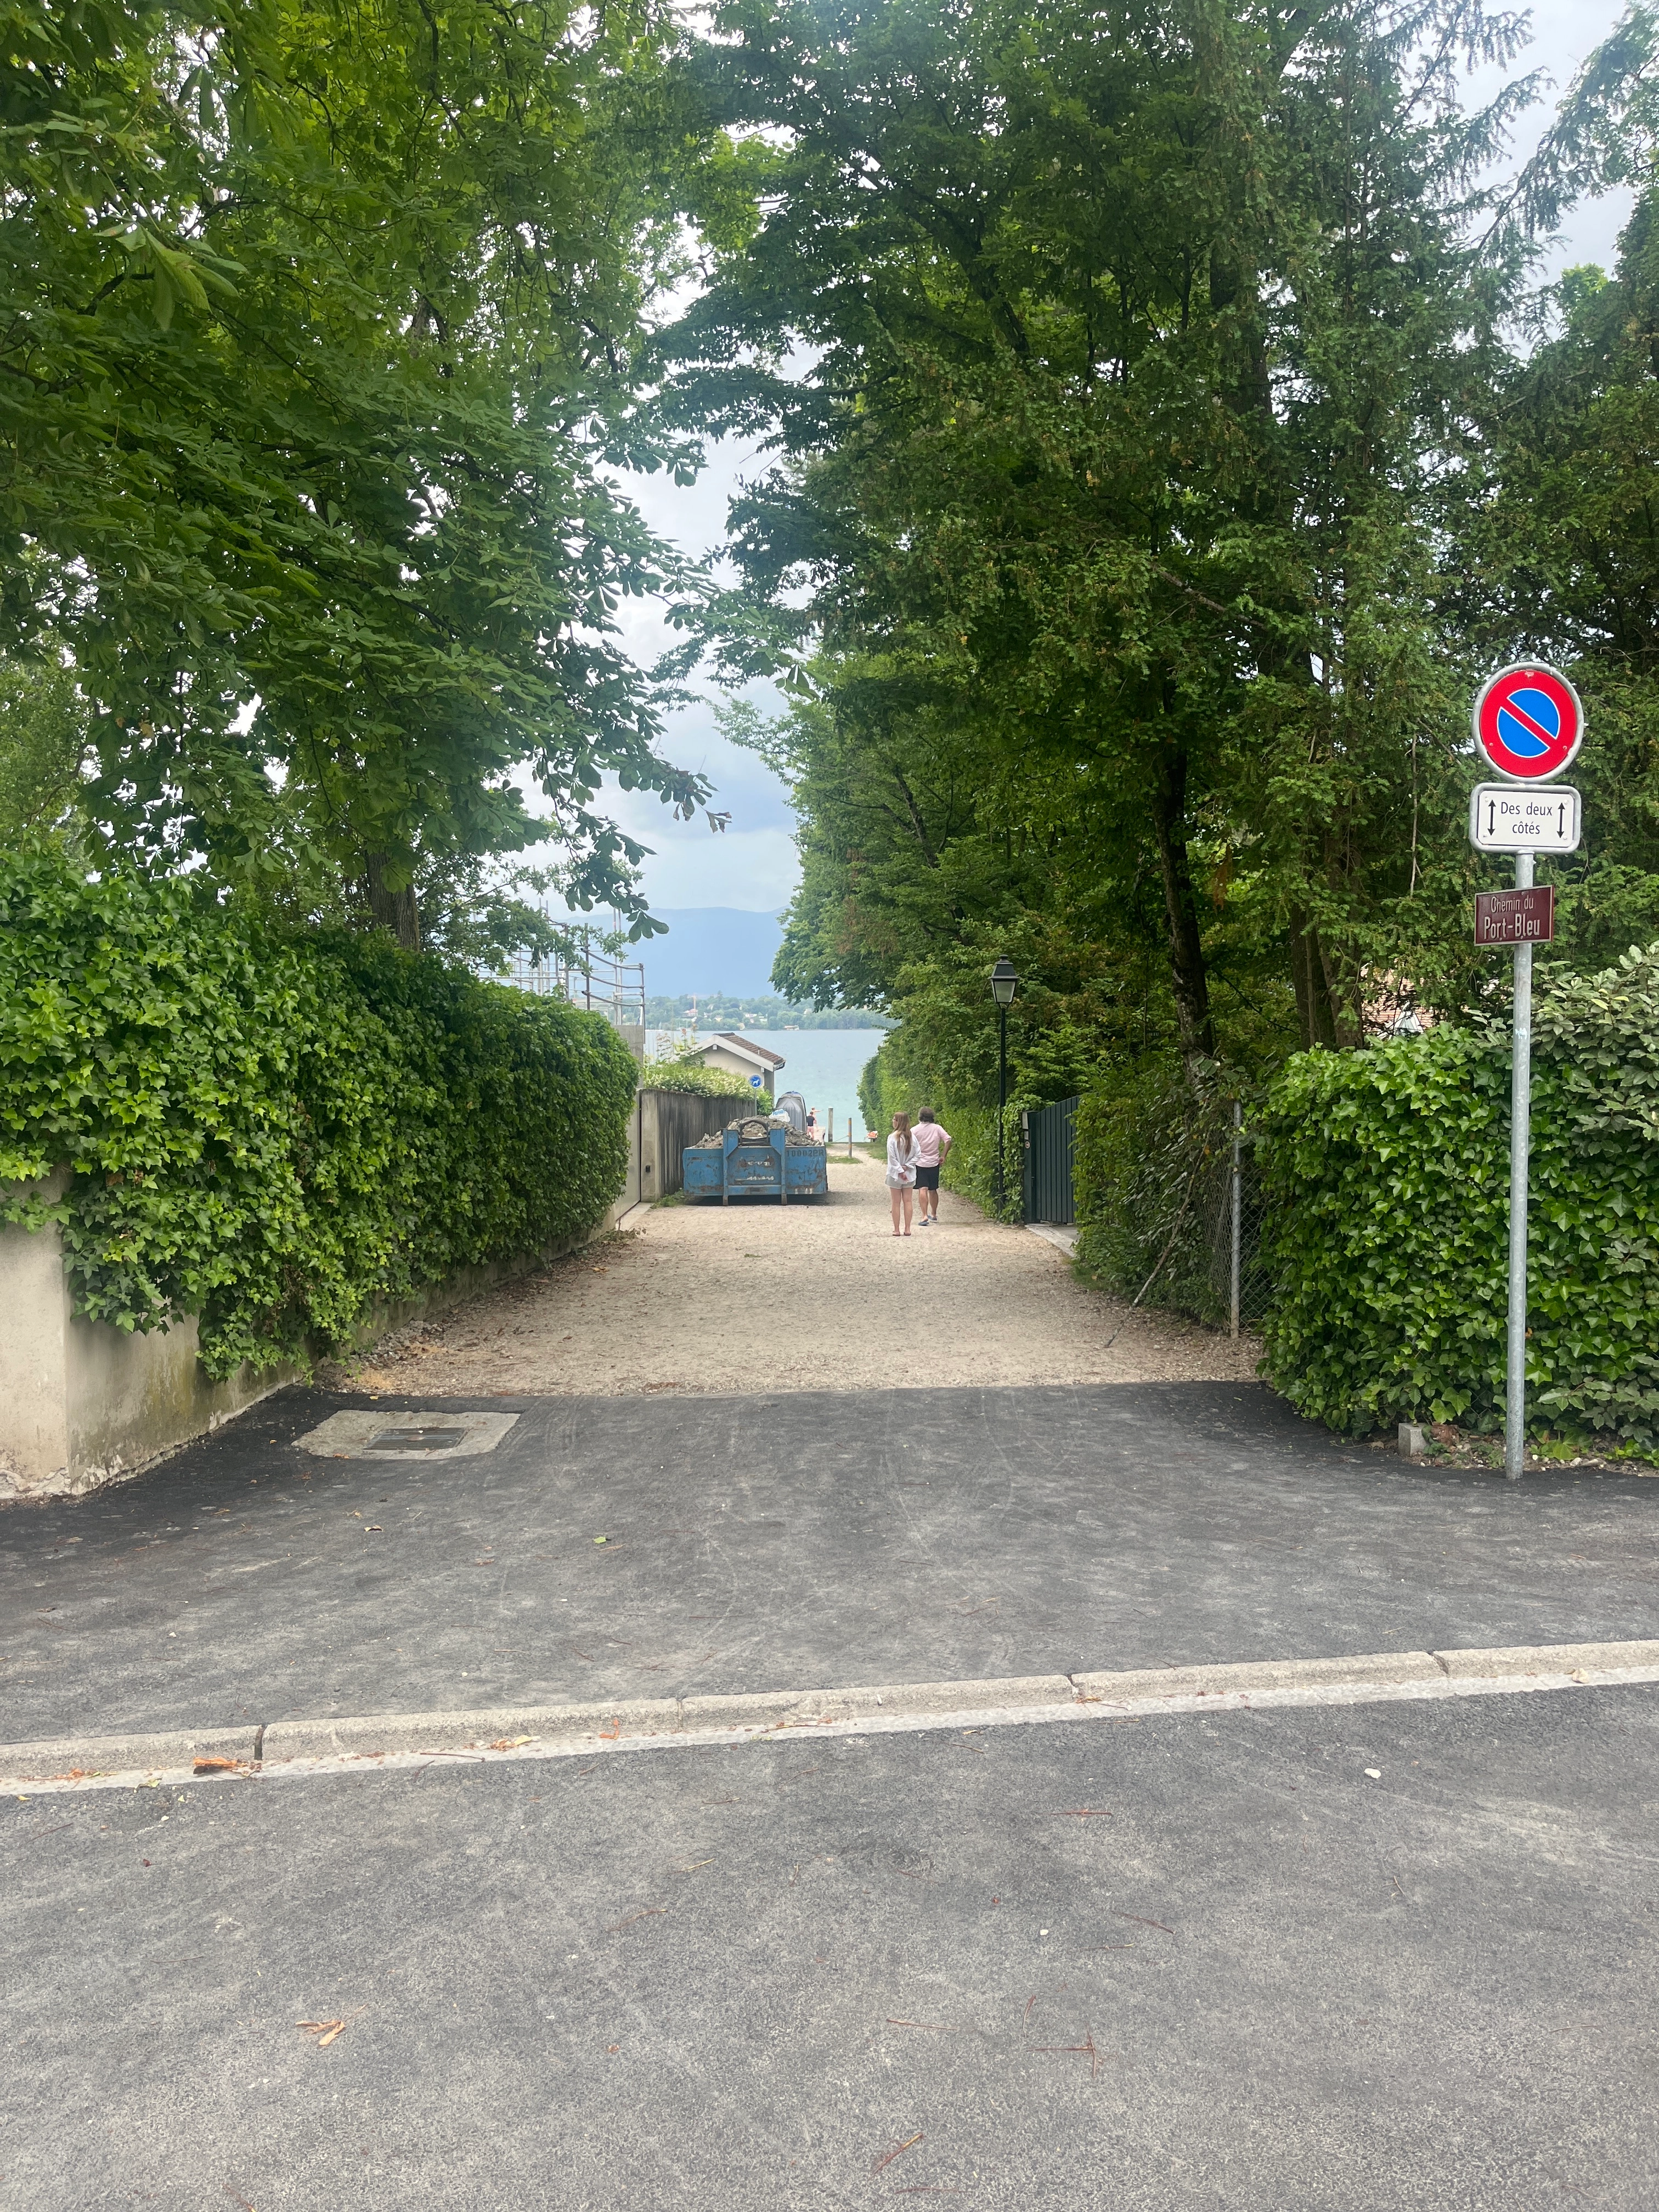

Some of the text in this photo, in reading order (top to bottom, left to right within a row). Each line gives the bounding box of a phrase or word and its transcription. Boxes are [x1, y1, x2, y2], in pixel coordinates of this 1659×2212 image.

[1500, 802, 1553, 816] Des deux
[1512, 821, 1540, 834] côtés
[1491, 894, 1534, 913] Chemin du
[1483, 913, 1541, 940] Port-Bleu
